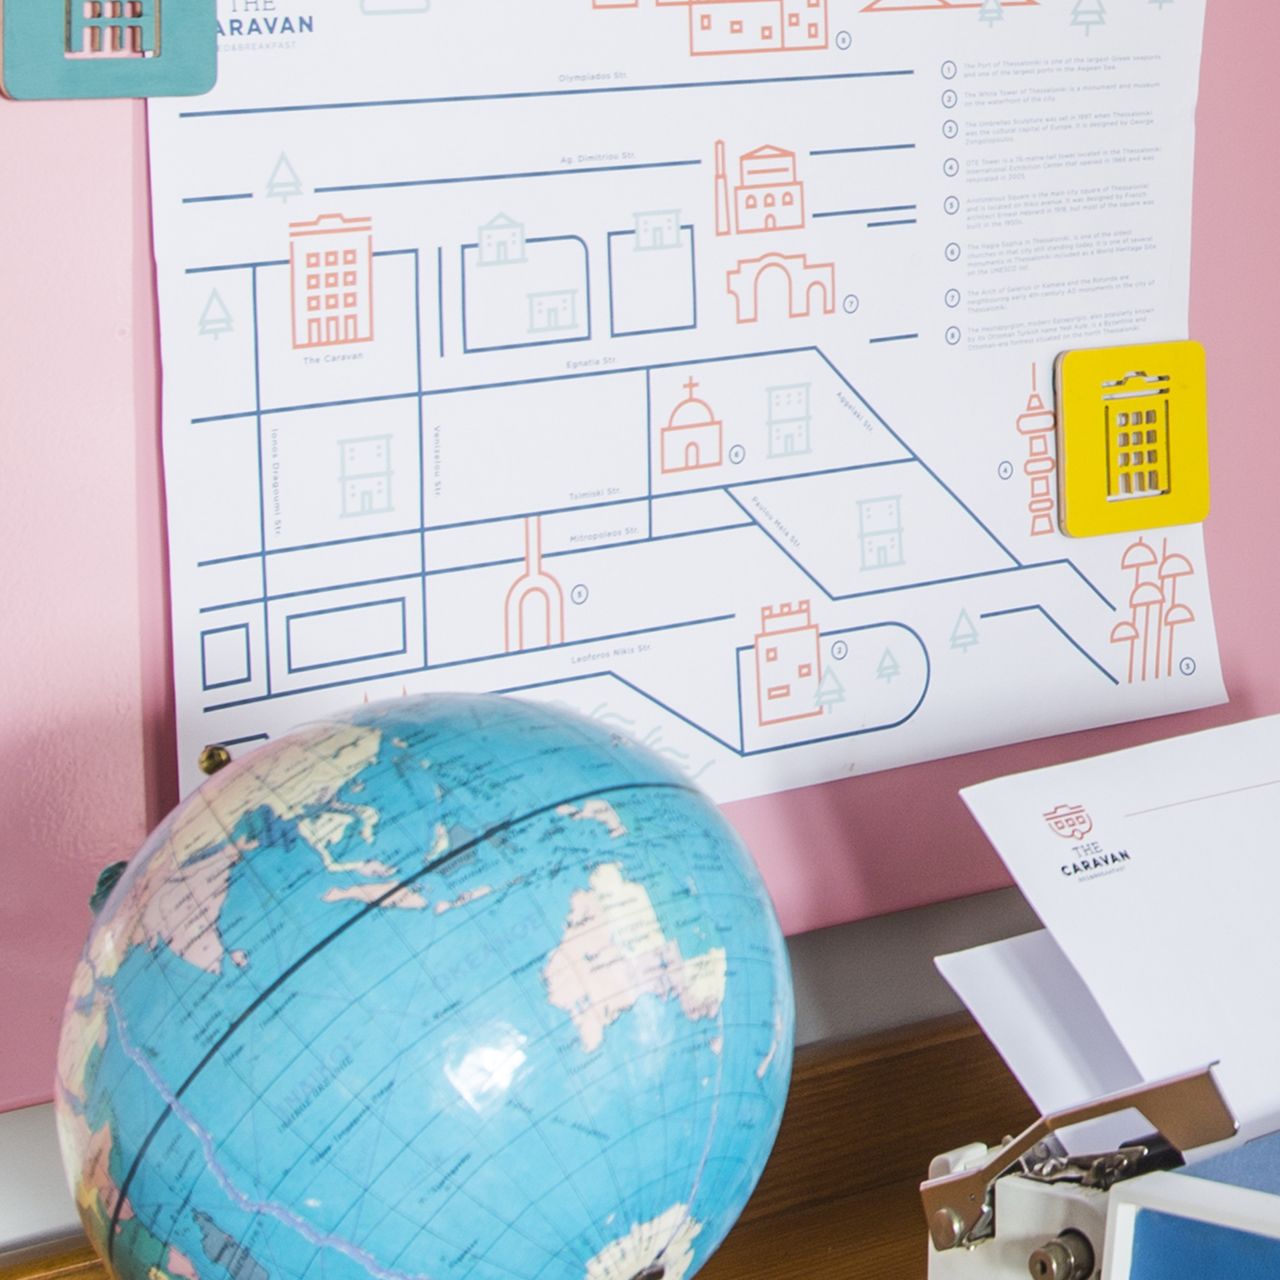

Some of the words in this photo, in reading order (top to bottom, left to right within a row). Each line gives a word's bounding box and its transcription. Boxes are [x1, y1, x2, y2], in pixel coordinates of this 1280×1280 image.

[216, 15, 314, 36] ARAVAN
[324, 352, 363, 363] Caravan
[1071, 841, 1104, 859] THE
[1060, 850, 1131, 877] CARAVAN
